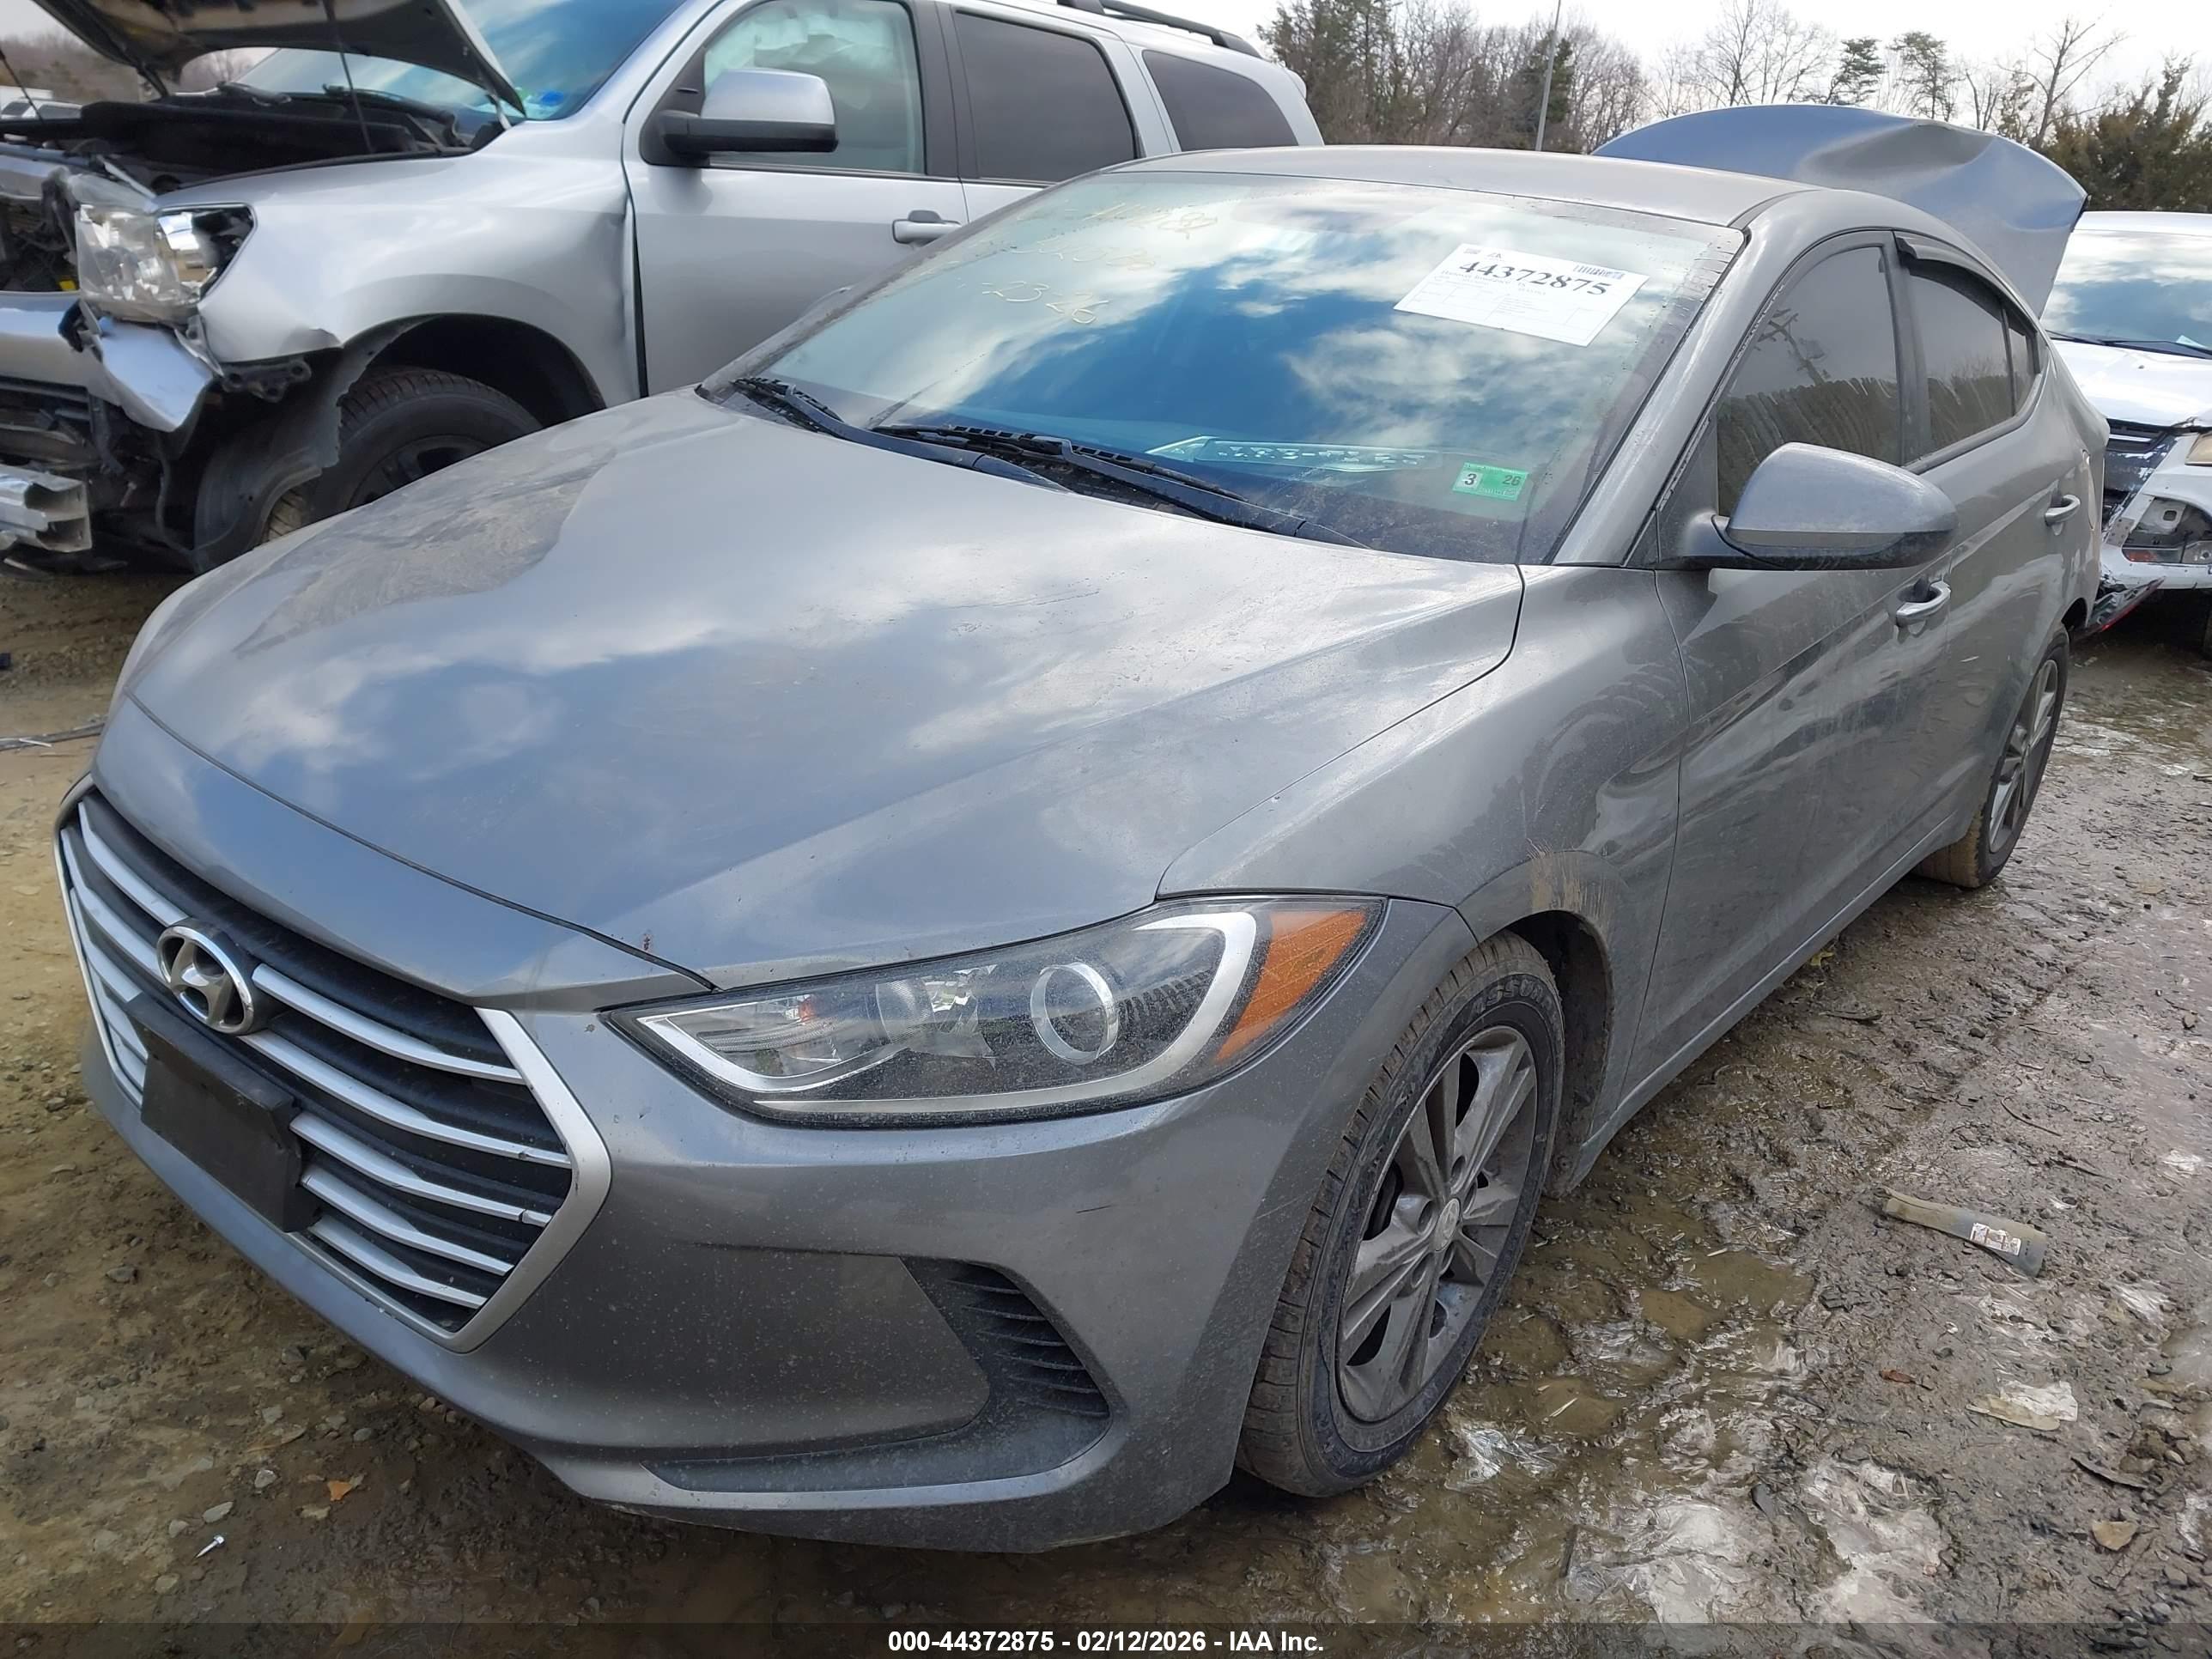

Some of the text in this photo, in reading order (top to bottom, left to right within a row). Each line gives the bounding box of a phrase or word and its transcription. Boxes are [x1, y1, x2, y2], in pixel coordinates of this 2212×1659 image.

[1459, 261, 1612, 295] 44372875
[1464, 473, 1522, 486] 3 26
